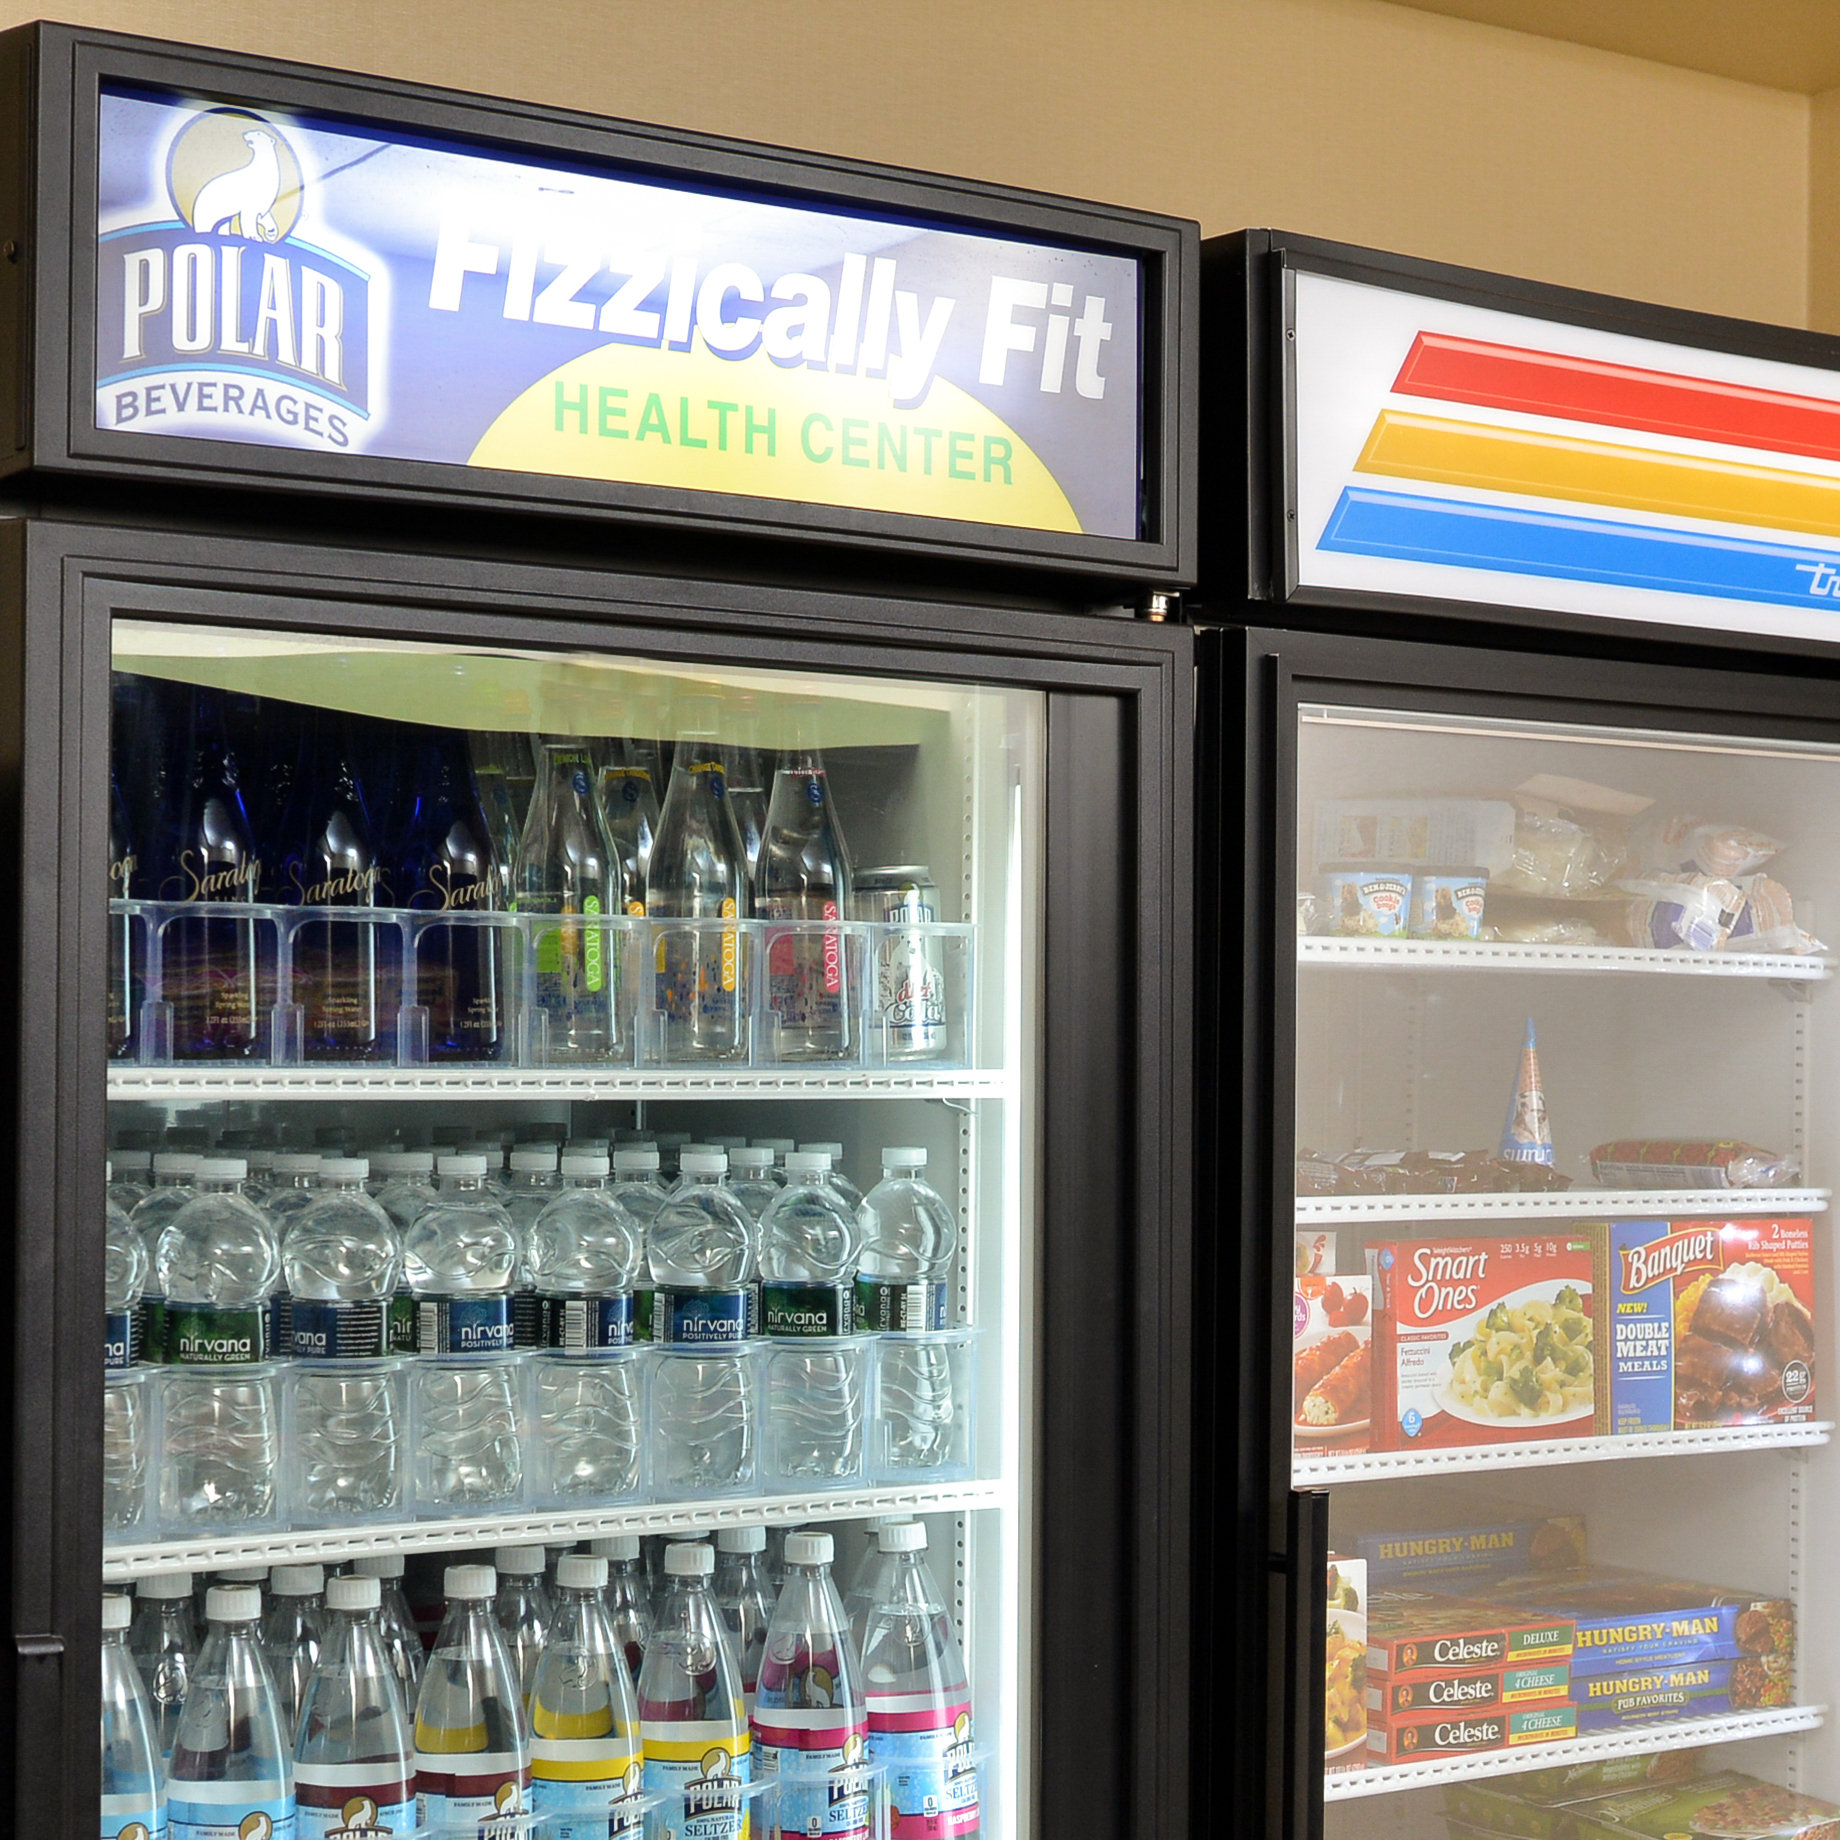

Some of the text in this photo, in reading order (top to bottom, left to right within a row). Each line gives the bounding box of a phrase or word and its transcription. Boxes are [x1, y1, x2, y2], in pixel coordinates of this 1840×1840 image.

[122, 239, 348, 393] POLAR
[428, 212, 1113, 408] Fizzically Fit
[110, 379, 352, 449] BEVERAGES
[554, 380, 1016, 486] HEALTH CENTER
[823, 903, 840, 990] SARATOGA
[1771, 1223, 1780, 1239] 2
[1407, 1247, 1488, 1287] Smart
[1628, 1231, 1715, 1290] Banquet
[1413, 1281, 1478, 1319] Ones
[1616, 1302, 1648, 1314] NEW!
[682, 1316, 745, 1333] nirvana
[767, 1306, 828, 1325] nirvana
[460, 1323, 515, 1340] nirvana
[681, 1332, 727, 1342] POSITIVELY
[767, 1323, 828, 1334] NATURALLY GREEN
[1616, 1321, 1670, 1340] DOUBLE
[179, 1334, 252, 1355] nirvana
[460, 1338, 503, 1349] POSITIVELY
[1616, 1338, 1669, 1358] MEAT
[179, 1351, 252, 1362] NATURALLY GREEN
[1617, 1359, 1668, 1373] MEALS
[1379, 1531, 1516, 1560] HUNGRY-MAN
[1576, 1616, 1720, 1648] HUNGRY-MAN
[1433, 1637, 1499, 1663] Celeste
[1522, 1630, 1560, 1646] DELUXE
[1521, 1674, 1556, 1688] CHEESE
[1588, 1669, 1710, 1698] HUNGRY-MAN
[1428, 1679, 1493, 1704] Celeste
[1635, 1691, 1686, 1709] FAVORITES
[1527, 1715, 1564, 1730] CHEESE
[1434, 1721, 1500, 1746] Celeste
